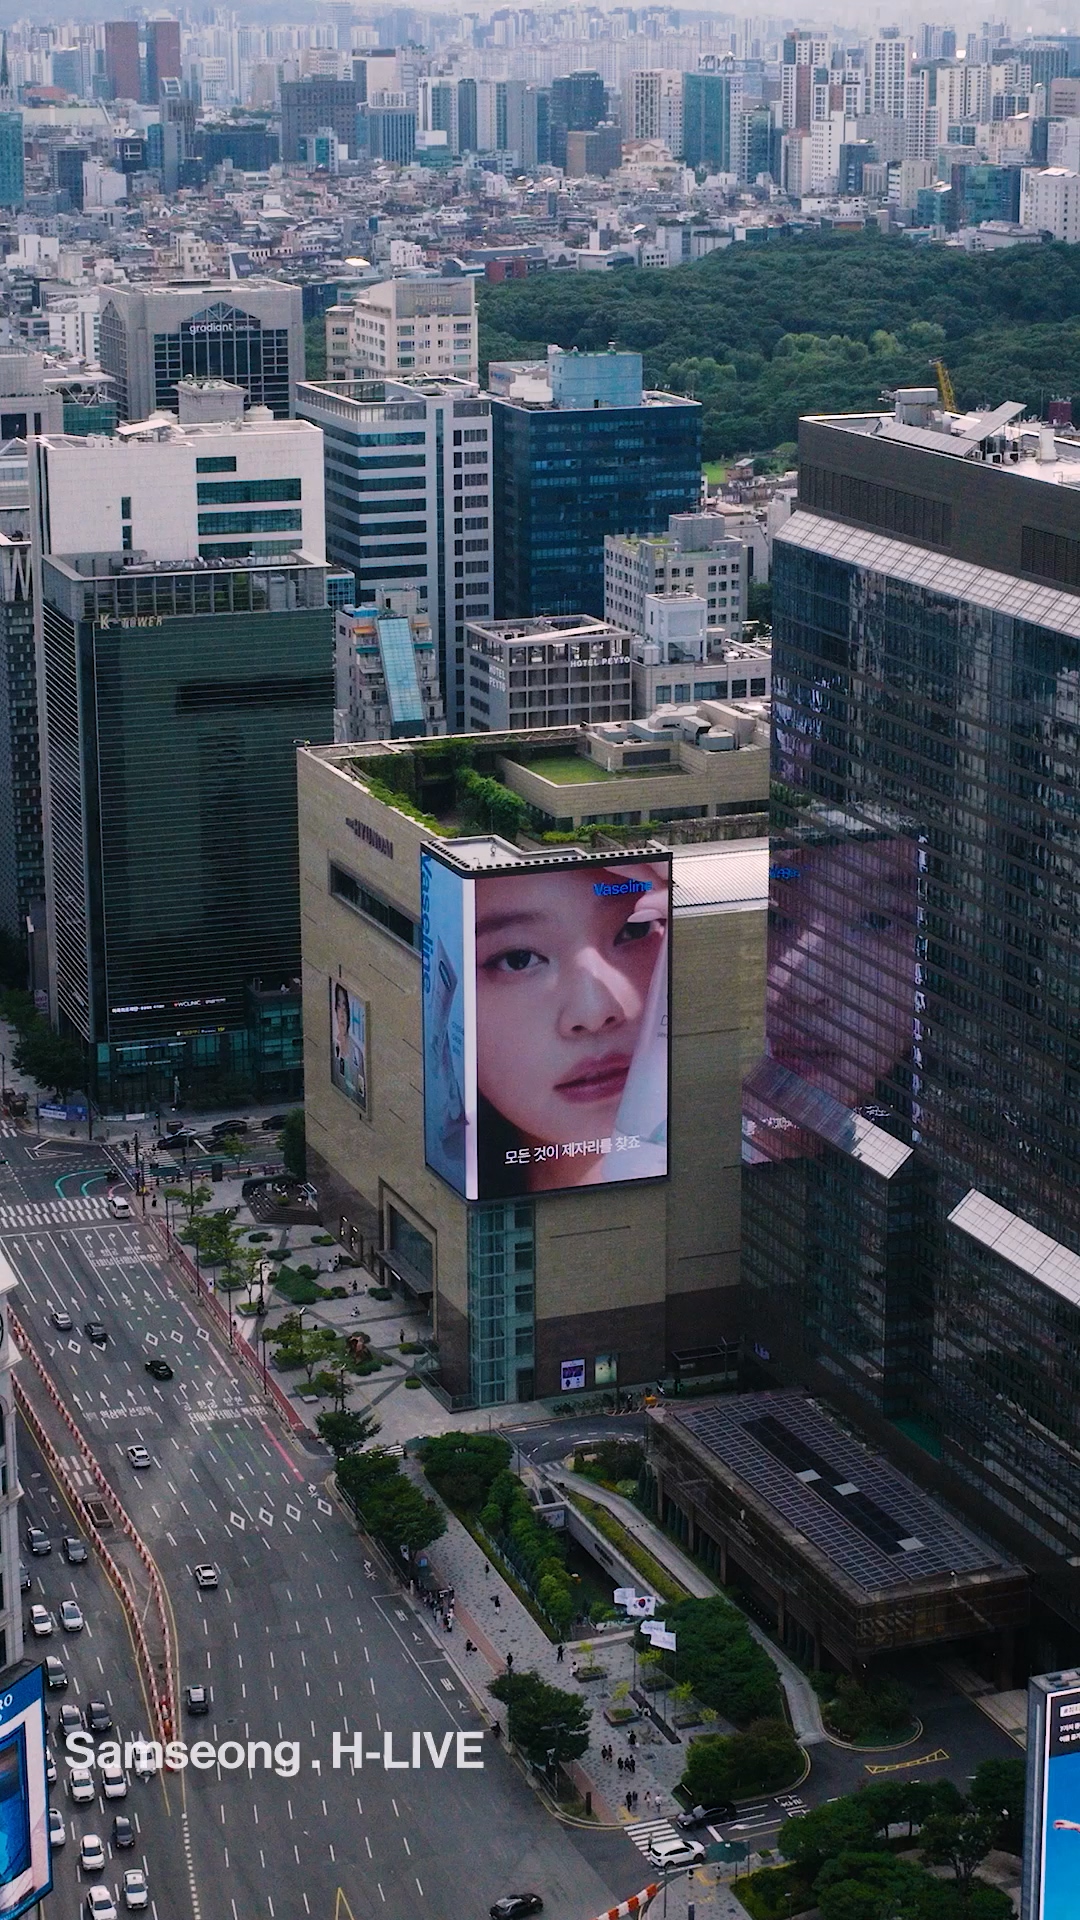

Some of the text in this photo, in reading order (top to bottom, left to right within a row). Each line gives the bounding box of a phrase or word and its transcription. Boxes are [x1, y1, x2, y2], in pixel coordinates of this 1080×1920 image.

[189, 323, 233, 335] gradiant
[121, 615, 163, 629] TOWER
[570, 656, 631, 668] HOTEL PEYTO
[593, 878, 653, 896] Vaseline
[421, 854, 434, 994] Vaseline
[504, 1135, 641, 1165] 모든 것이 제자리를 찾죠
